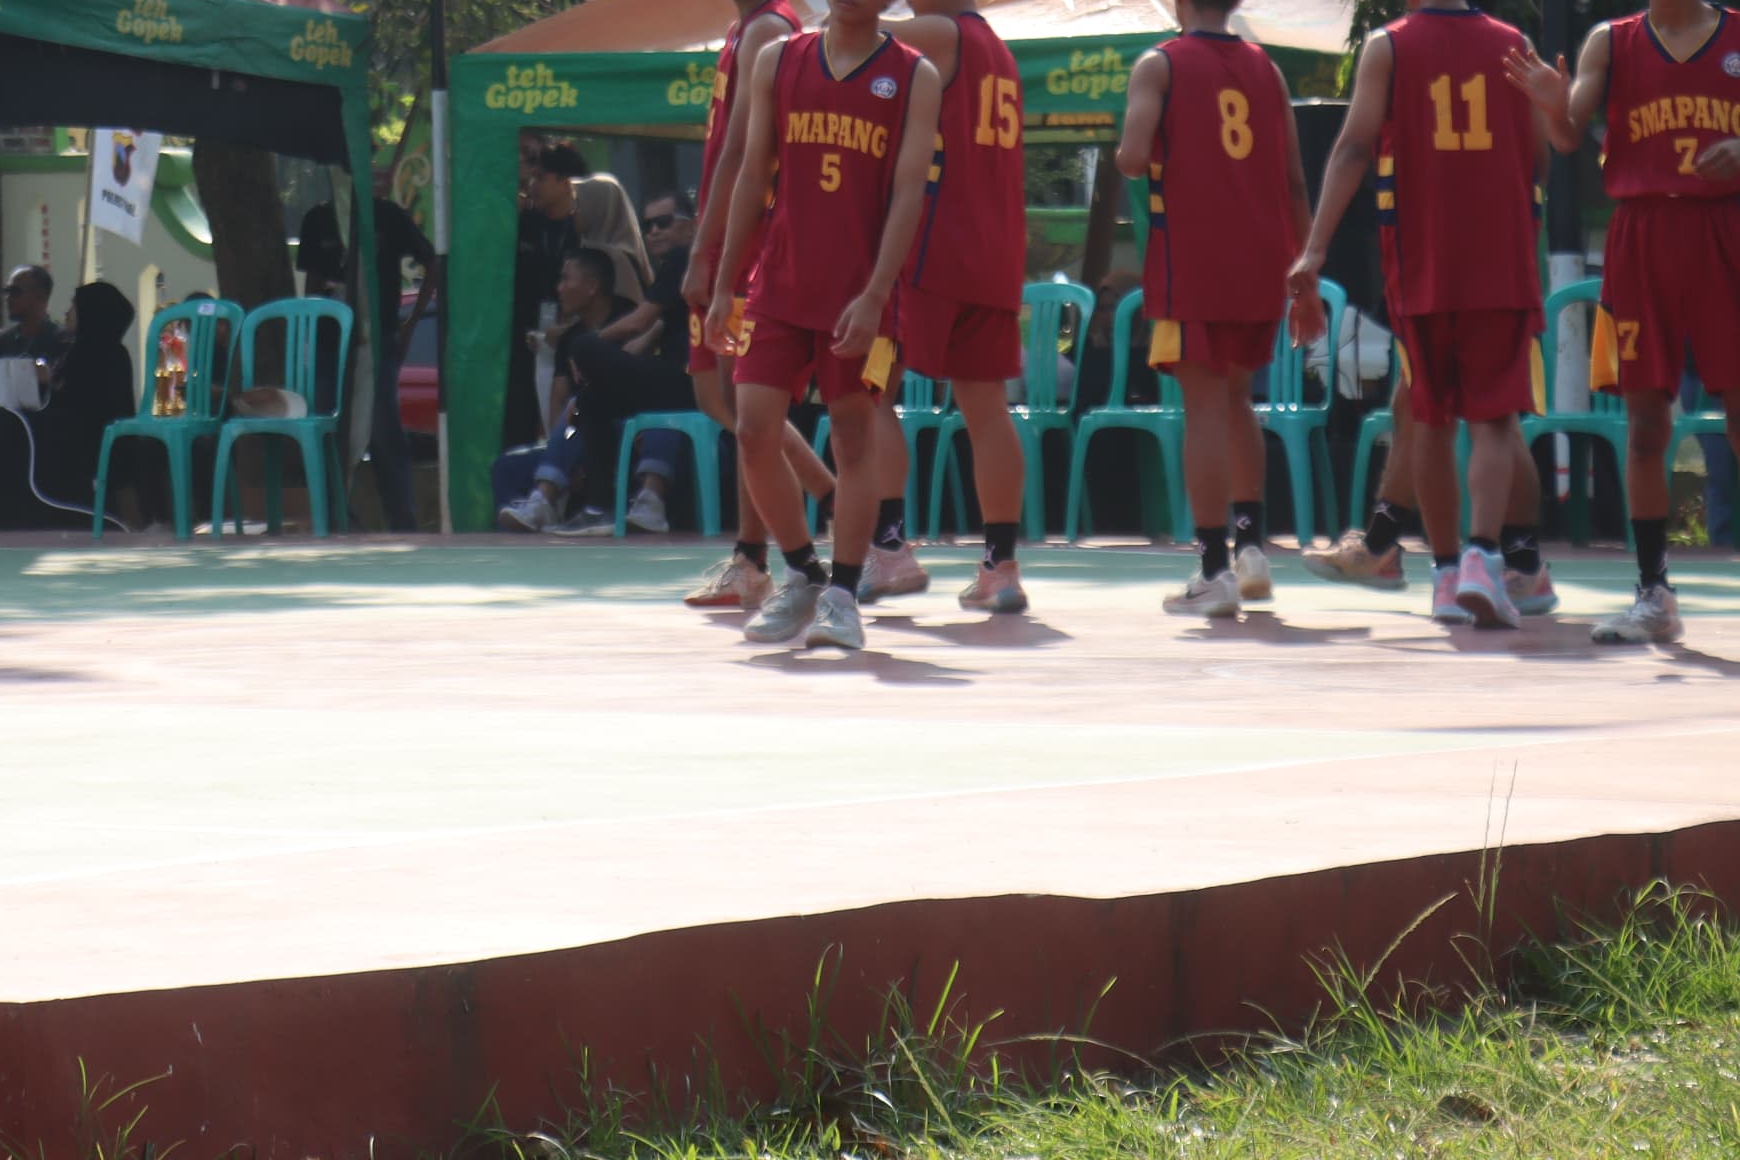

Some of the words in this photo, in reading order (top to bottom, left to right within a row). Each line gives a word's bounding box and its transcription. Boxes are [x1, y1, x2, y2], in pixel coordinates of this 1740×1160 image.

[116, 8, 184, 44] Gopek
[305, 19, 339, 43] teh
[290, 34, 353, 70] Gopek
[1069, 47, 1124, 73] teh
[506, 63, 554, 88] teh
[686, 62, 717, 84] te
[1046, 68, 1128, 100] Gope
[485, 81, 579, 115] Gopek
[975, 74, 1021, 150] 15
[1429, 72, 1493, 151] 11
[1217, 88, 1254, 160] 8
[819, 152, 843, 192] 5
[1673, 138, 1699, 174] 7
[689, 314, 702, 347] 9
[737, 320, 756, 356] 5
[1618, 321, 1640, 360] 7
